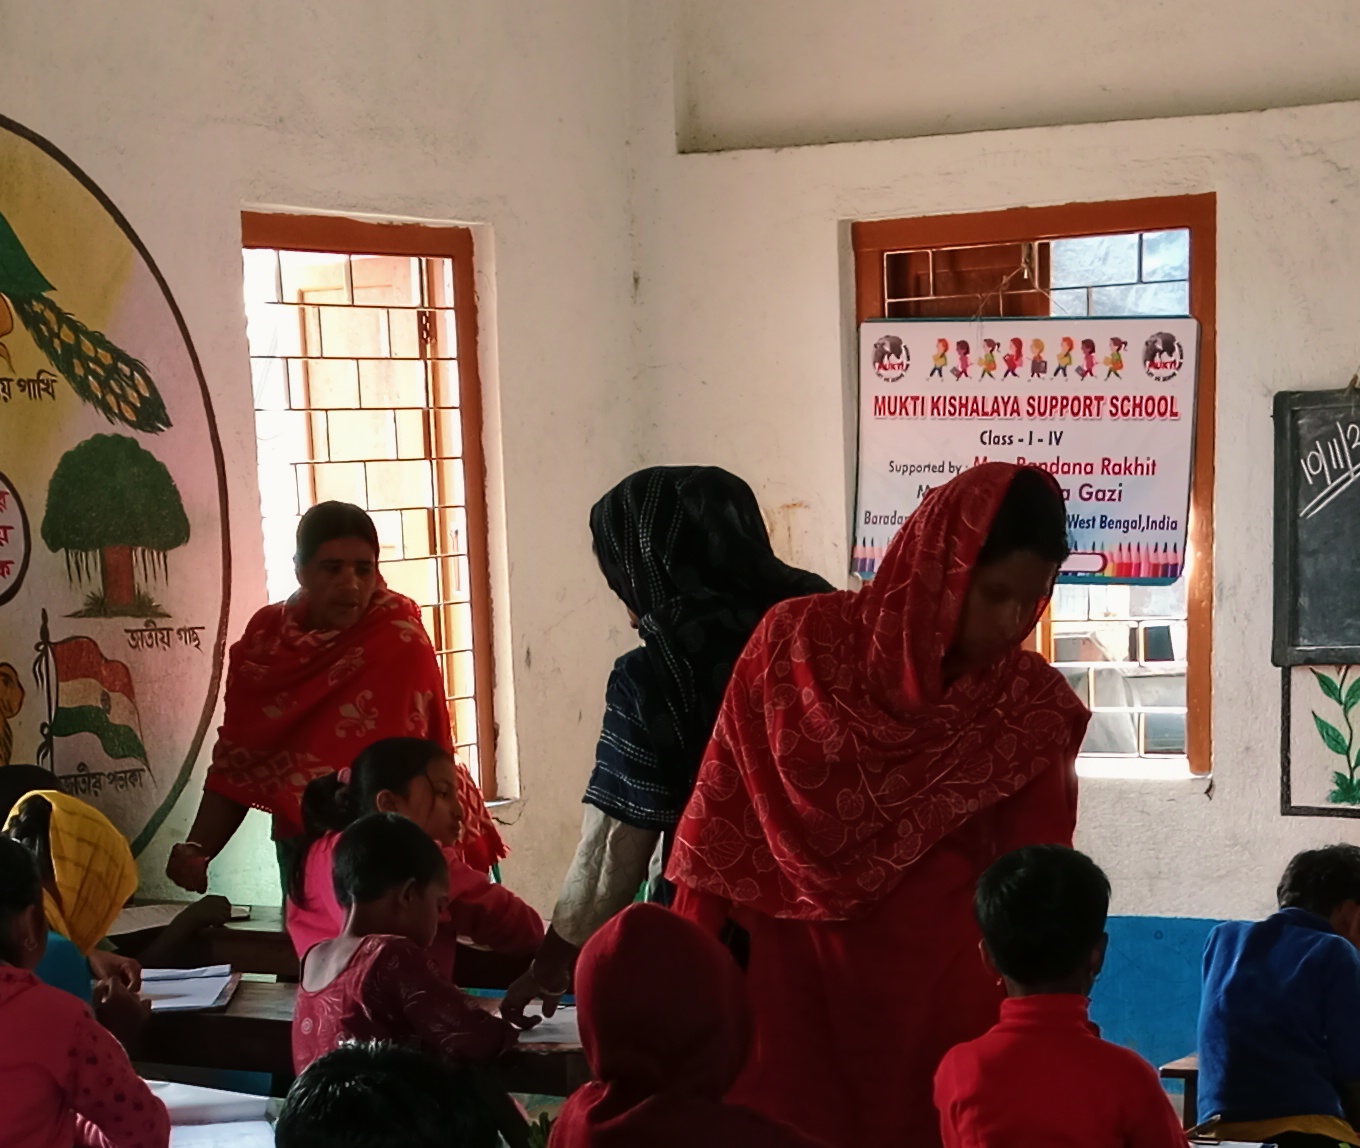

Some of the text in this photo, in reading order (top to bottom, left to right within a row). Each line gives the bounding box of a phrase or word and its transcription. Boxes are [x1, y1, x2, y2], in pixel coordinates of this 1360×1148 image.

[16, 368, 58, 401] পাখি
[873, 395, 1179, 418] MUKTI KISHALAYA SUPPORT SCHOOL
[979, 430, 1014, 446] Class
[1048, 430, 1064, 446] IV
[888, 460, 945, 476] Supported
[1100, 456, 1157, 476] Rakhit
[1078, 482, 1123, 503] Gazi
[1066, 514, 1096, 530] West
[124, 618, 173, 652] জাতীয়
